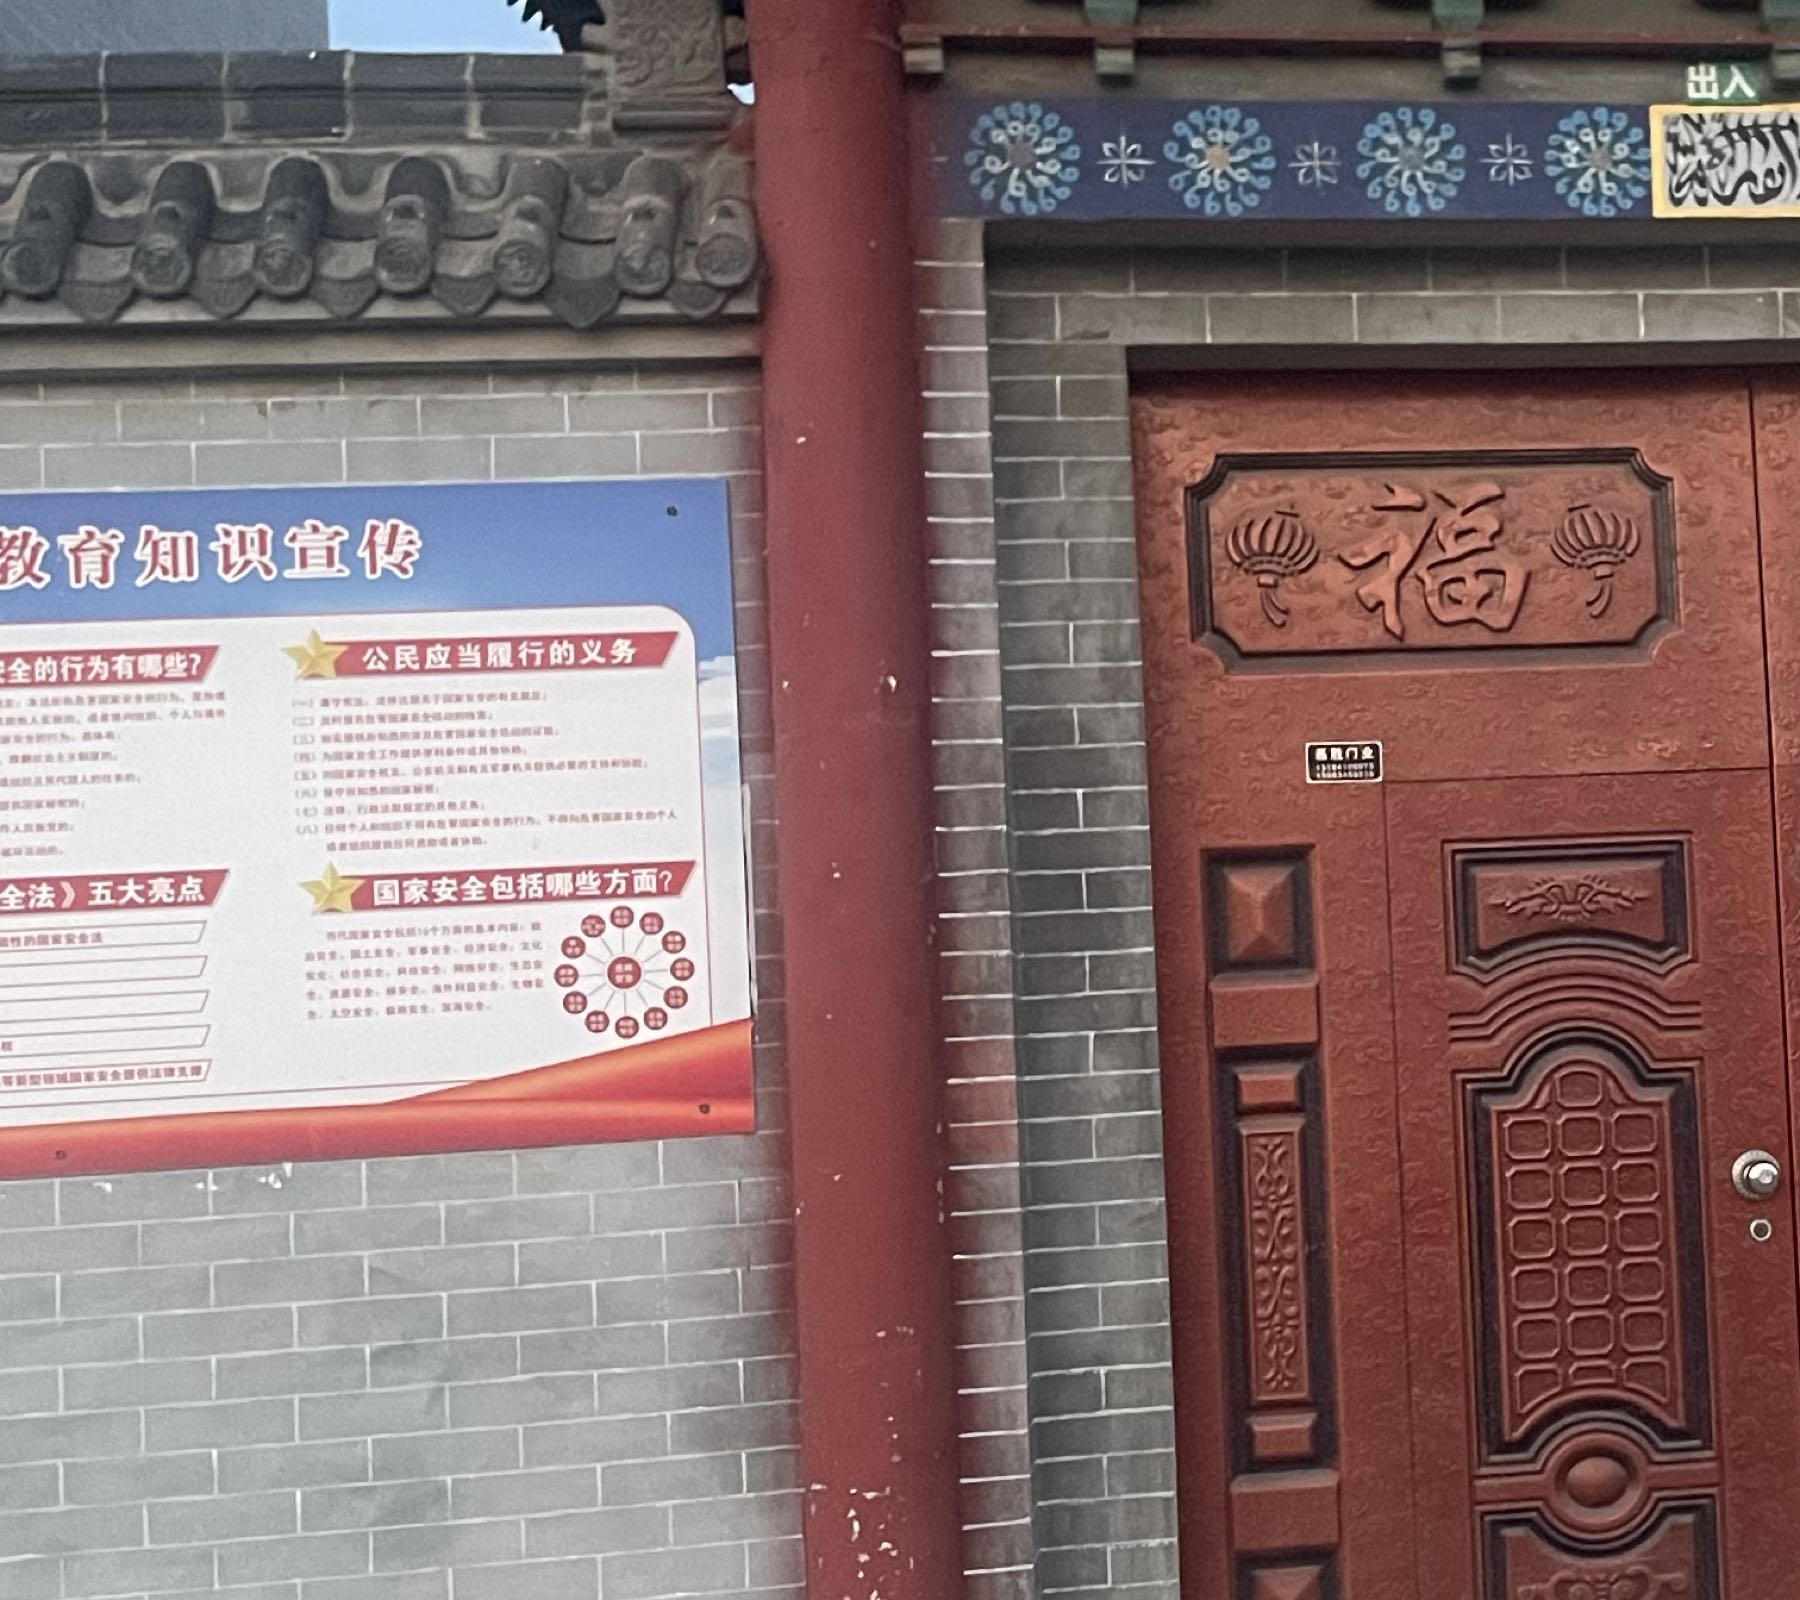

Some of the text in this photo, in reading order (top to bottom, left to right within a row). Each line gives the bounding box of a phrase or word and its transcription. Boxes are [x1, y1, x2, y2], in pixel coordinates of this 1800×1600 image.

[1686, 63, 1757, 100] 出入
[0, 519, 426, 590] 教育知识宣传
[1336, 482, 1533, 641] 福
[361, 640, 638, 673] 公民应当履行的义务
